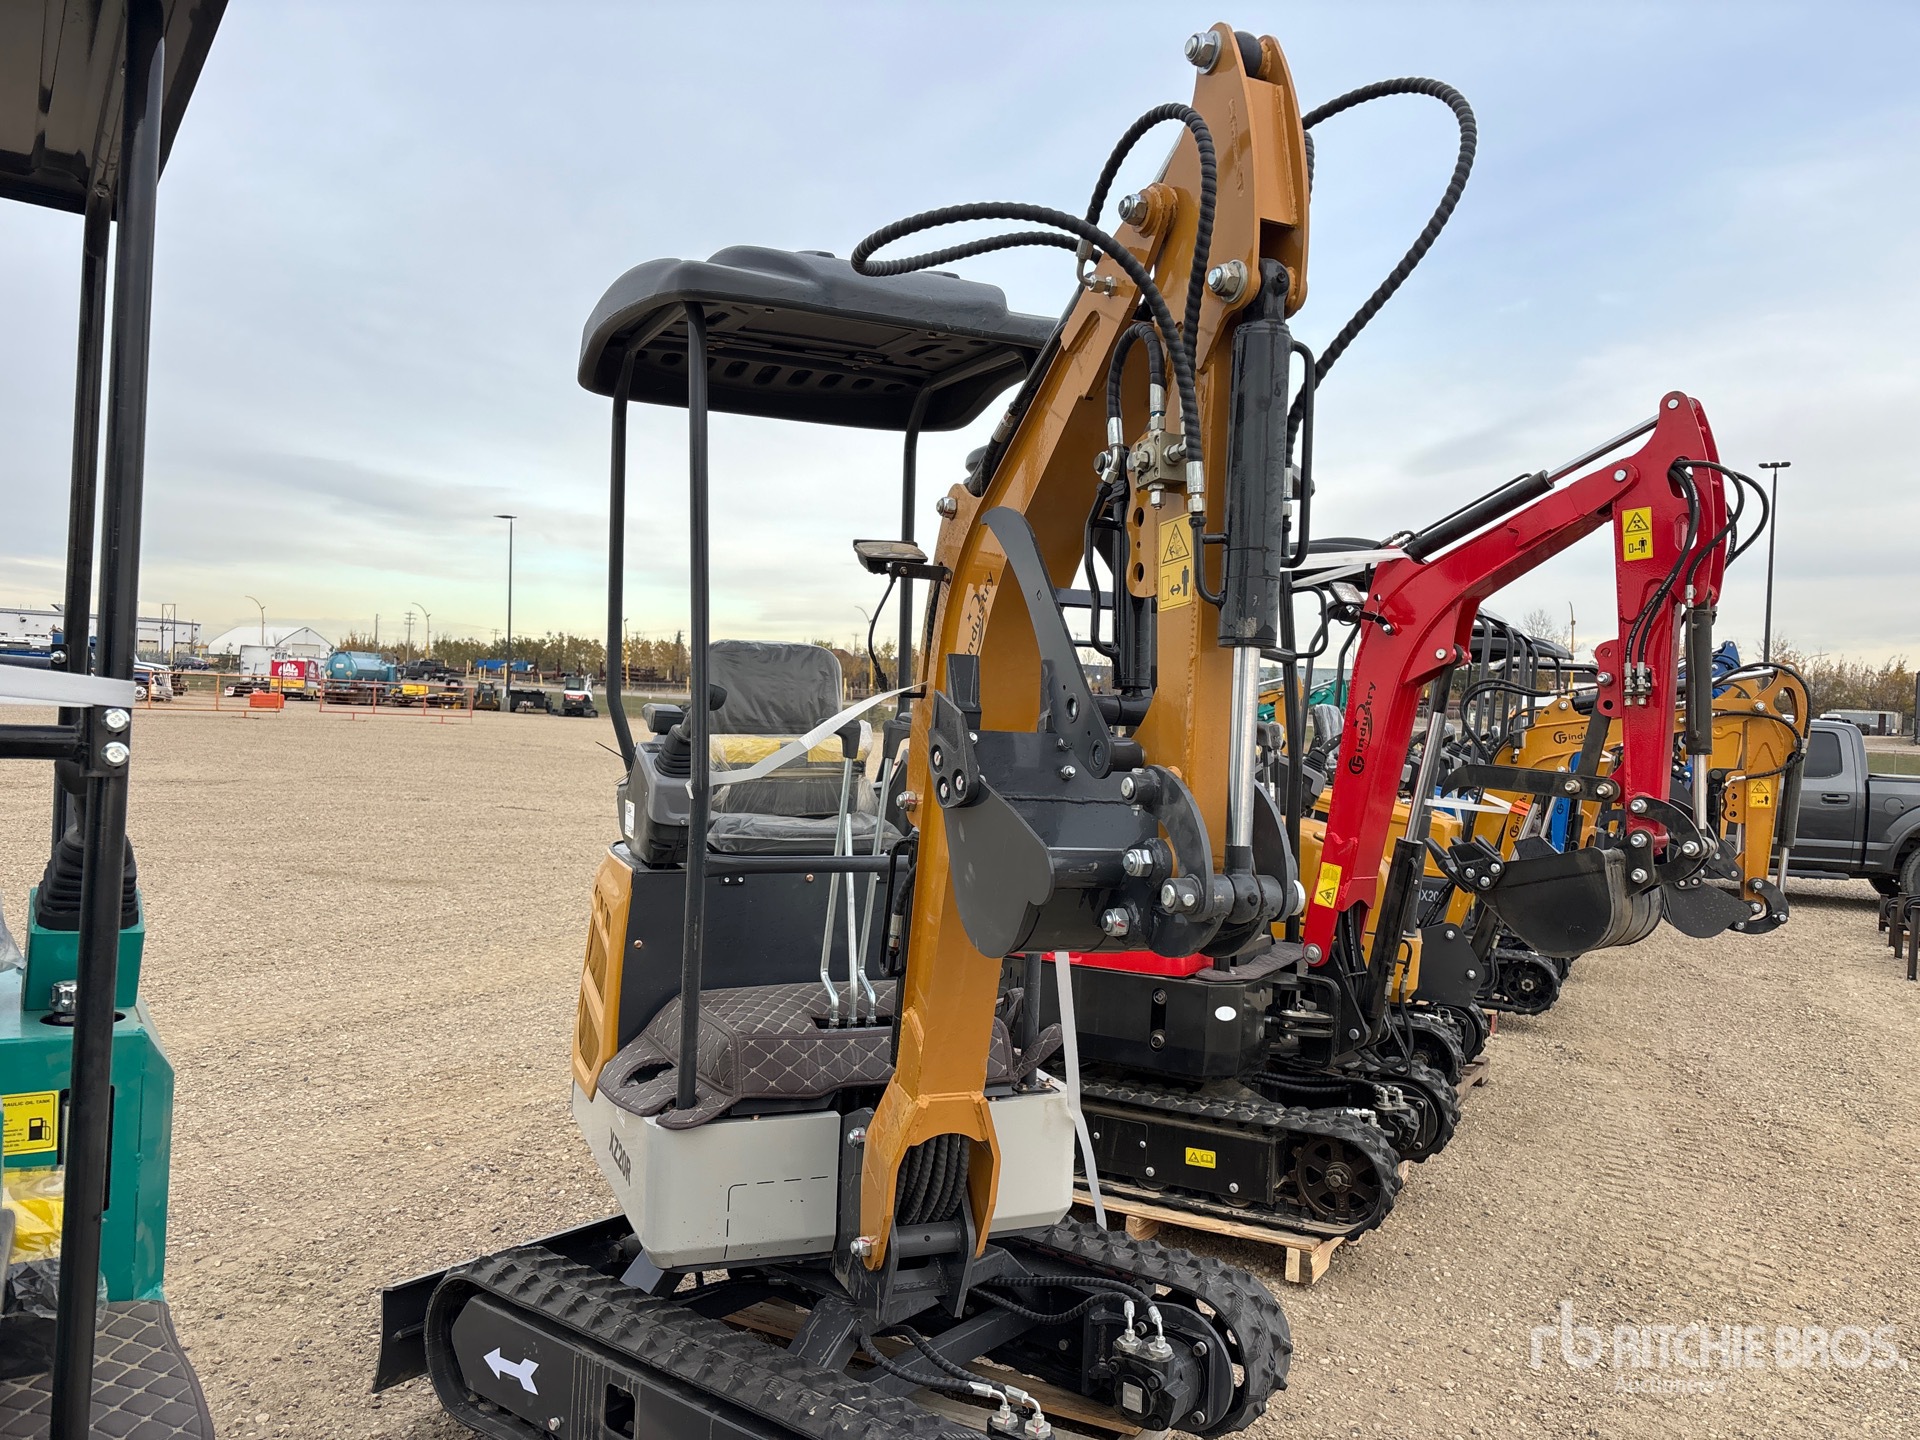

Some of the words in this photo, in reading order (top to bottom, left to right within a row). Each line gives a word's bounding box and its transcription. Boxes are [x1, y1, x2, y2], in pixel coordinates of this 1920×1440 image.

[964, 570, 996, 655] ndustry
[1353, 680, 1377, 753] industry
[1418, 889, 1440, 902] X20
